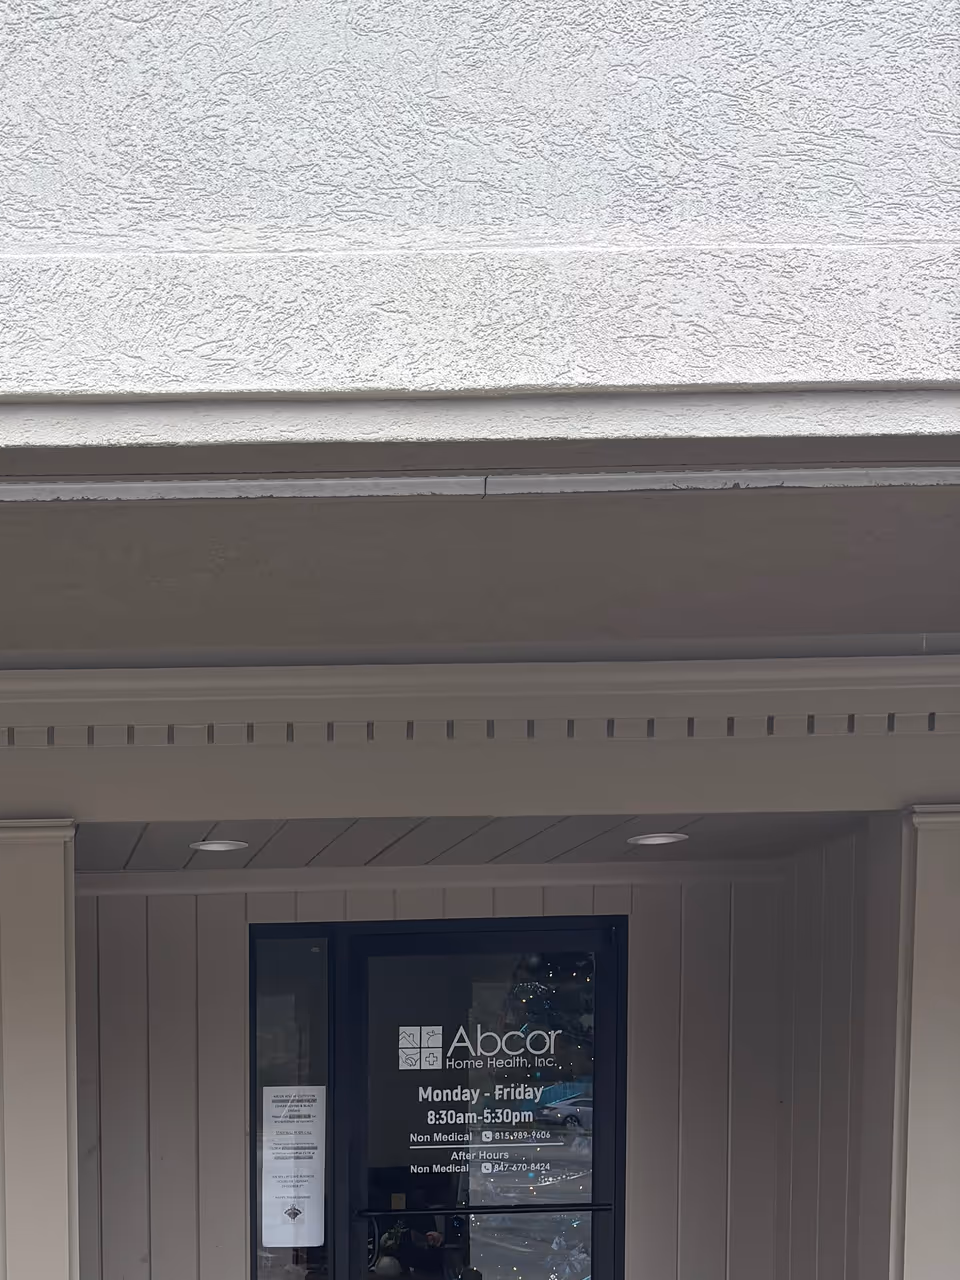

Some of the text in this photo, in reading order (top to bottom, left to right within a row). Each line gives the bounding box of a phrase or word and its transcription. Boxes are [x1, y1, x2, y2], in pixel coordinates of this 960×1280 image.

[446, 1024, 562, 1057] Abcor
[446, 1056, 557, 1069] Home Health, Inc.
[418, 1085, 480, 1104] Monday
[494, 1083, 544, 1103] Friday
[427, 1109, 533, 1126] 8:30am-5:30pm
[410, 1133, 430, 1142] Non
[433, 1132, 473, 1142] Medical
[451, 1151, 509, 1161] After Hours
[410, 1163, 551, 1174] Non Medical 847-670-8424
